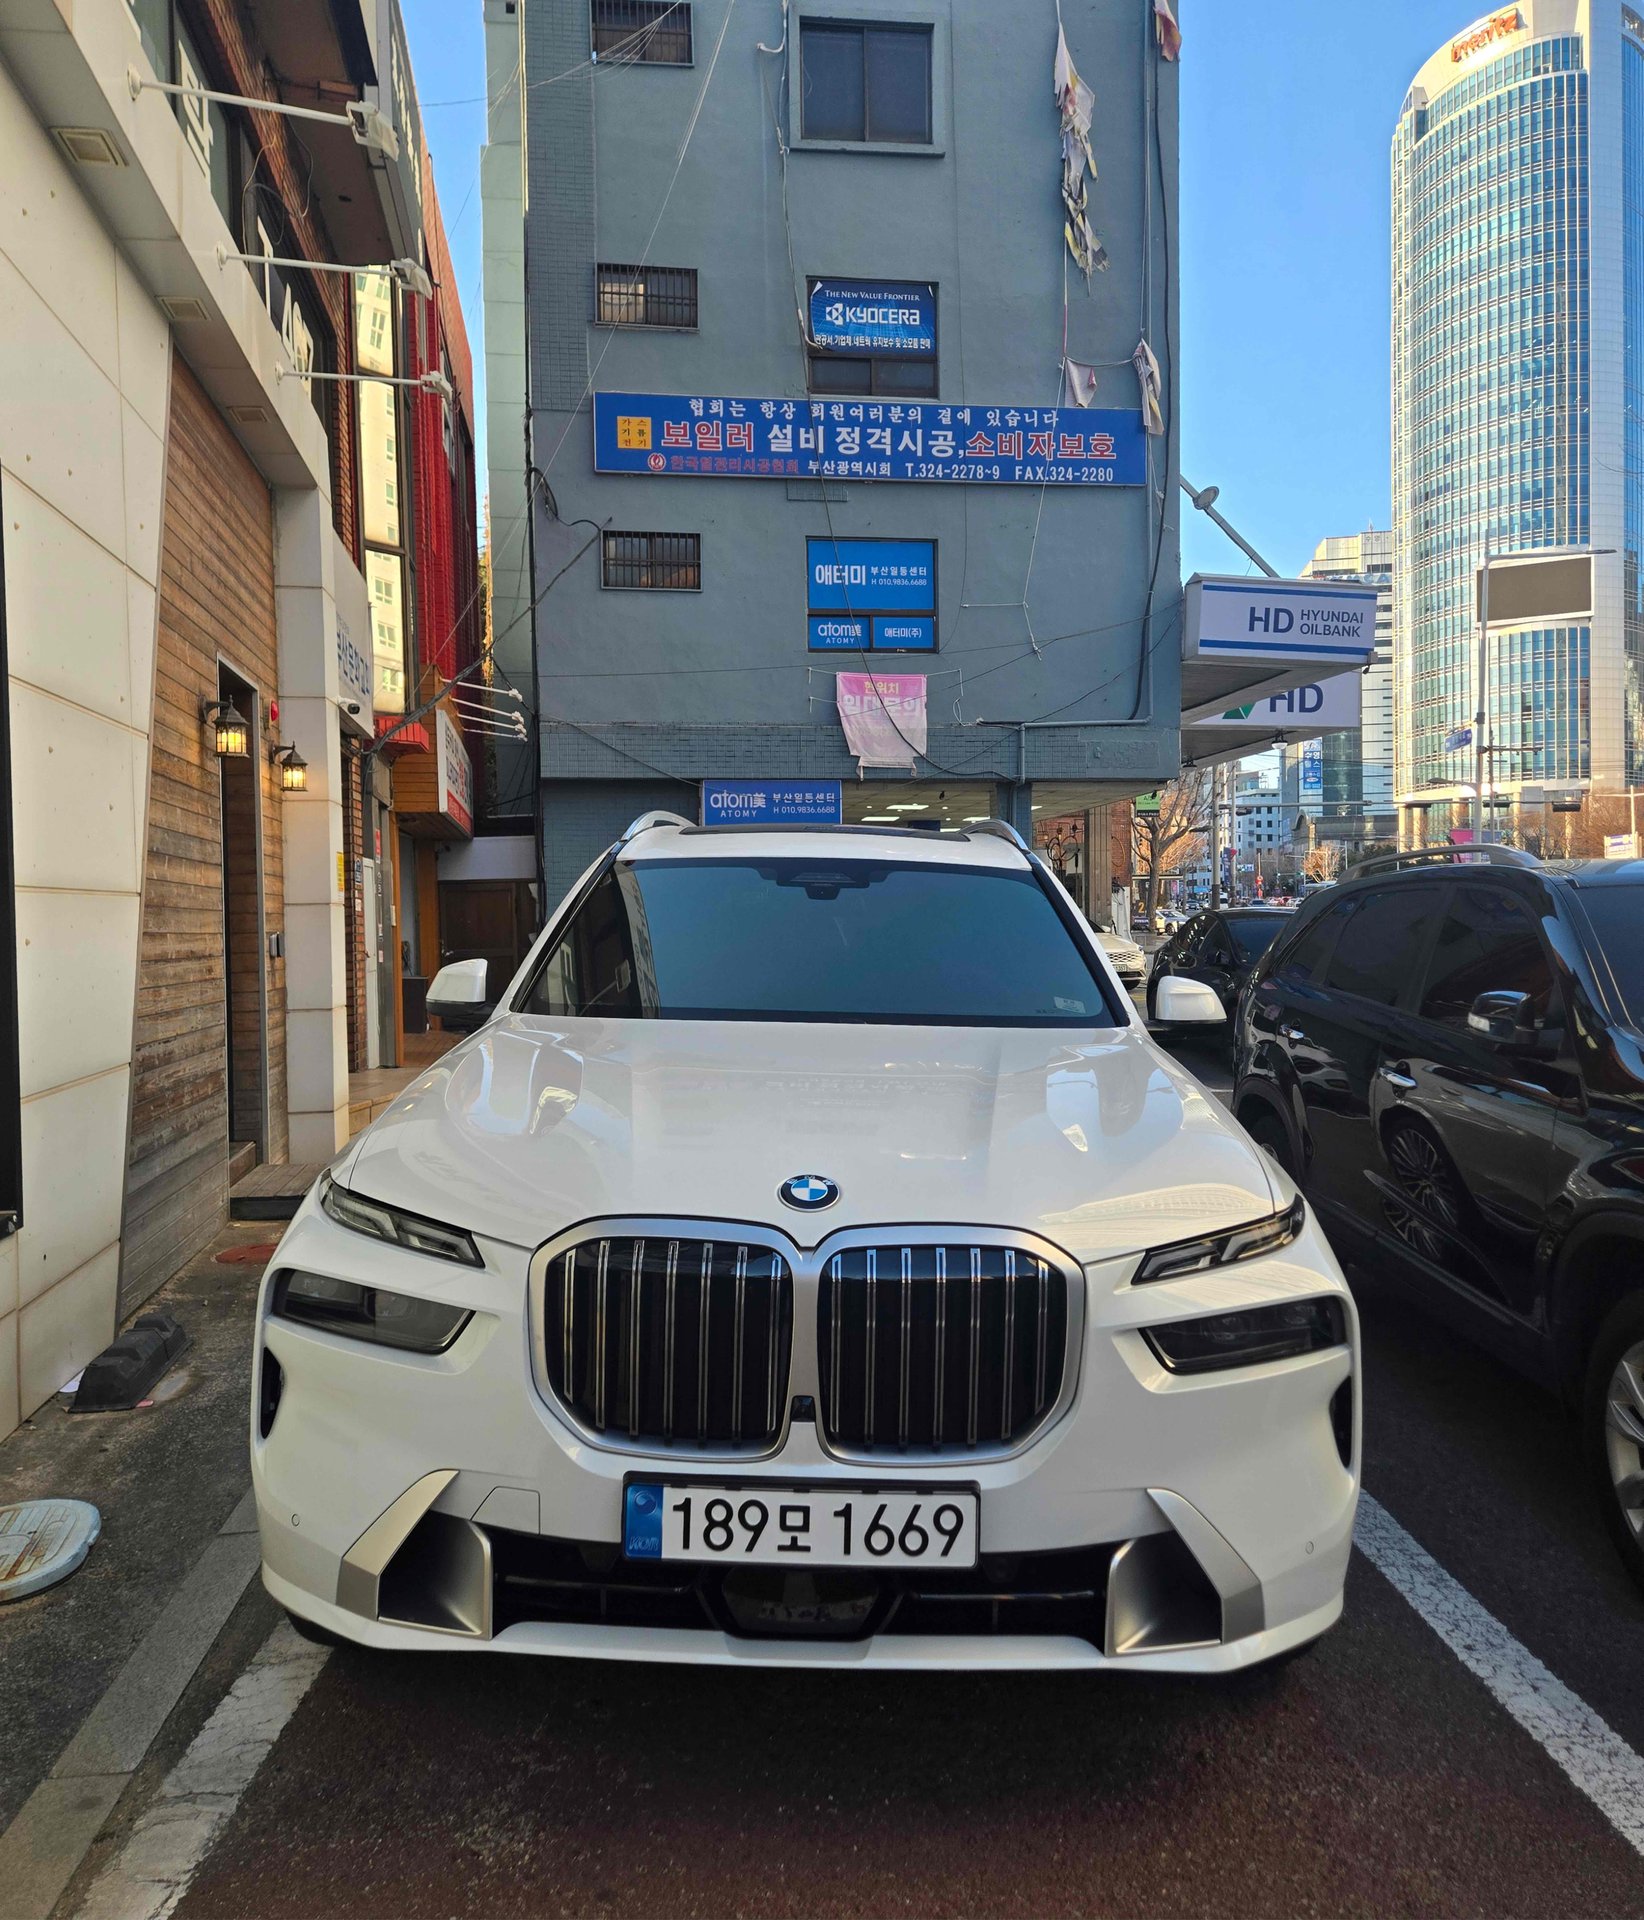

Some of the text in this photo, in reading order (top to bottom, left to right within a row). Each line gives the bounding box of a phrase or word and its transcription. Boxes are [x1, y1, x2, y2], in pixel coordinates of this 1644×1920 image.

[824, 289, 920, 301] THE NEW VALUE FRONTIER
[846, 306, 920, 325] KYOCERA
[872, 336, 894, 348] 유지보수
[920, 338, 931, 349] 판매
[688, 398, 746, 418] 협회는
[759, 400, 796, 420] 항상
[811, 403, 922, 424] 회원여러분의
[986, 409, 1060, 428] 있습니다
[661, 420, 754, 453] 보일러
[767, 423, 825, 454] 설비
[808, 459, 891, 477] 부산광역시회
[905, 463, 1000, 480] T.324-2278~9
[1015, 465, 1114, 482] FAX.324-2280
[815, 564, 866, 586] 애터미
[870, 566, 927, 577] 부산일등센터
[1248, 606, 1294, 633] HD
[1300, 609, 1364, 624] HYUNDAI
[884, 627, 922, 638] 애터미(주)
[1300, 623, 1361, 637] OILBANK
[772, 792, 835, 804] 부산일등센터
[720, 810, 757, 818] ATOMY
[781, 806, 836, 814] 010.9836.6688
[672, 1496, 965, 1557] 189모 1669
